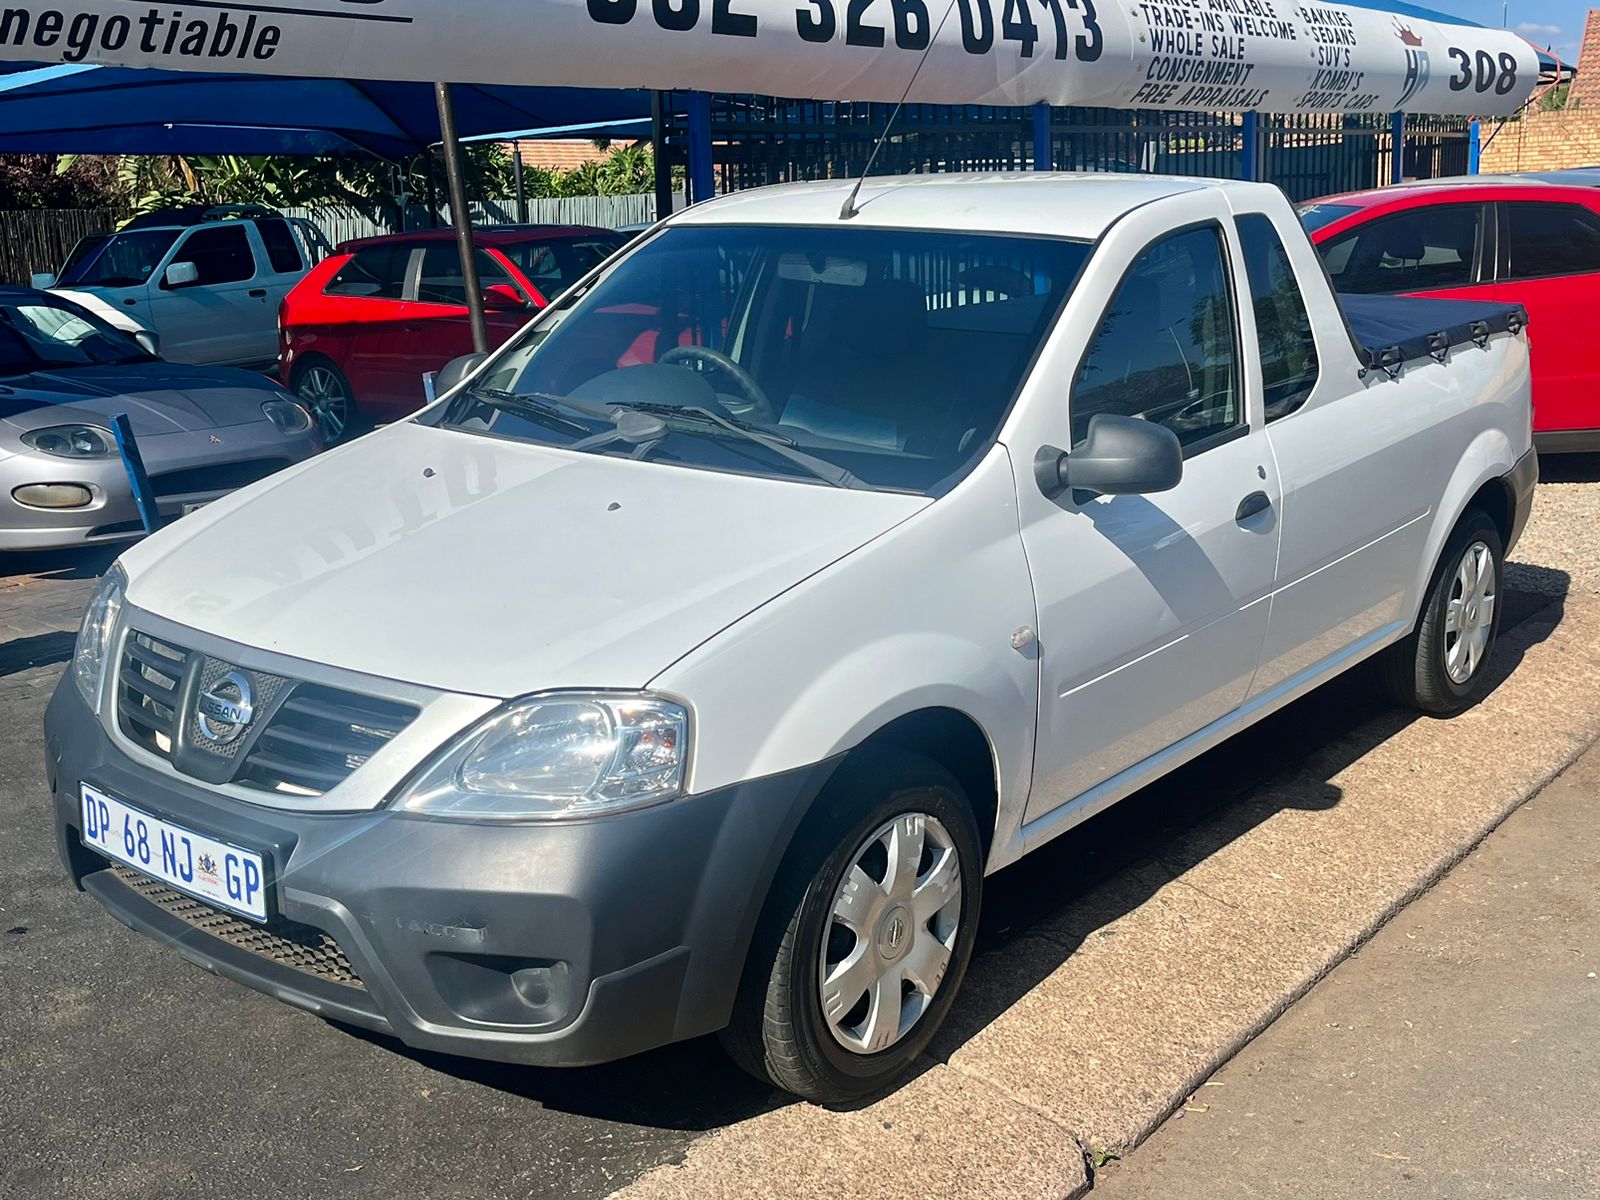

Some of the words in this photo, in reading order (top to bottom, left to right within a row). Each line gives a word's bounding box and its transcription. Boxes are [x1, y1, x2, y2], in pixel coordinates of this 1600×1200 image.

[1139, 4, 1224, 32] TRADE-INS
[1228, 15, 1297, 40] WELCOME
[1207, 0, 1277, 18] AVAILABLE
[1299, 7, 1352, 27] BAKKIES
[0, 8, 281, 62] negotiable
[958, 0, 1103, 62] 0413
[1149, 28, 1202, 56] WHOLE
[1211, 35, 1245, 60] SALE
[1311, 26, 1356, 46] SEDANS
[1146, 55, 1254, 86] CONSIGNMENT
[1318, 45, 1350, 68] SUV'S
[1309, 69, 1364, 91] KOMBI'S
[1448, 47, 1517, 95] 308
[1129, 82, 1179, 104] FREE
[1175, 85, 1269, 107] APPRAISALS
[1296, 91, 1347, 108] SPORTS
[1344, 94, 1379, 109] CARS
[85, 793, 110, 844] DP
[124, 813, 150, 865] 68
[161, 828, 193, 883] NJ
[225, 853, 260, 905] GP
